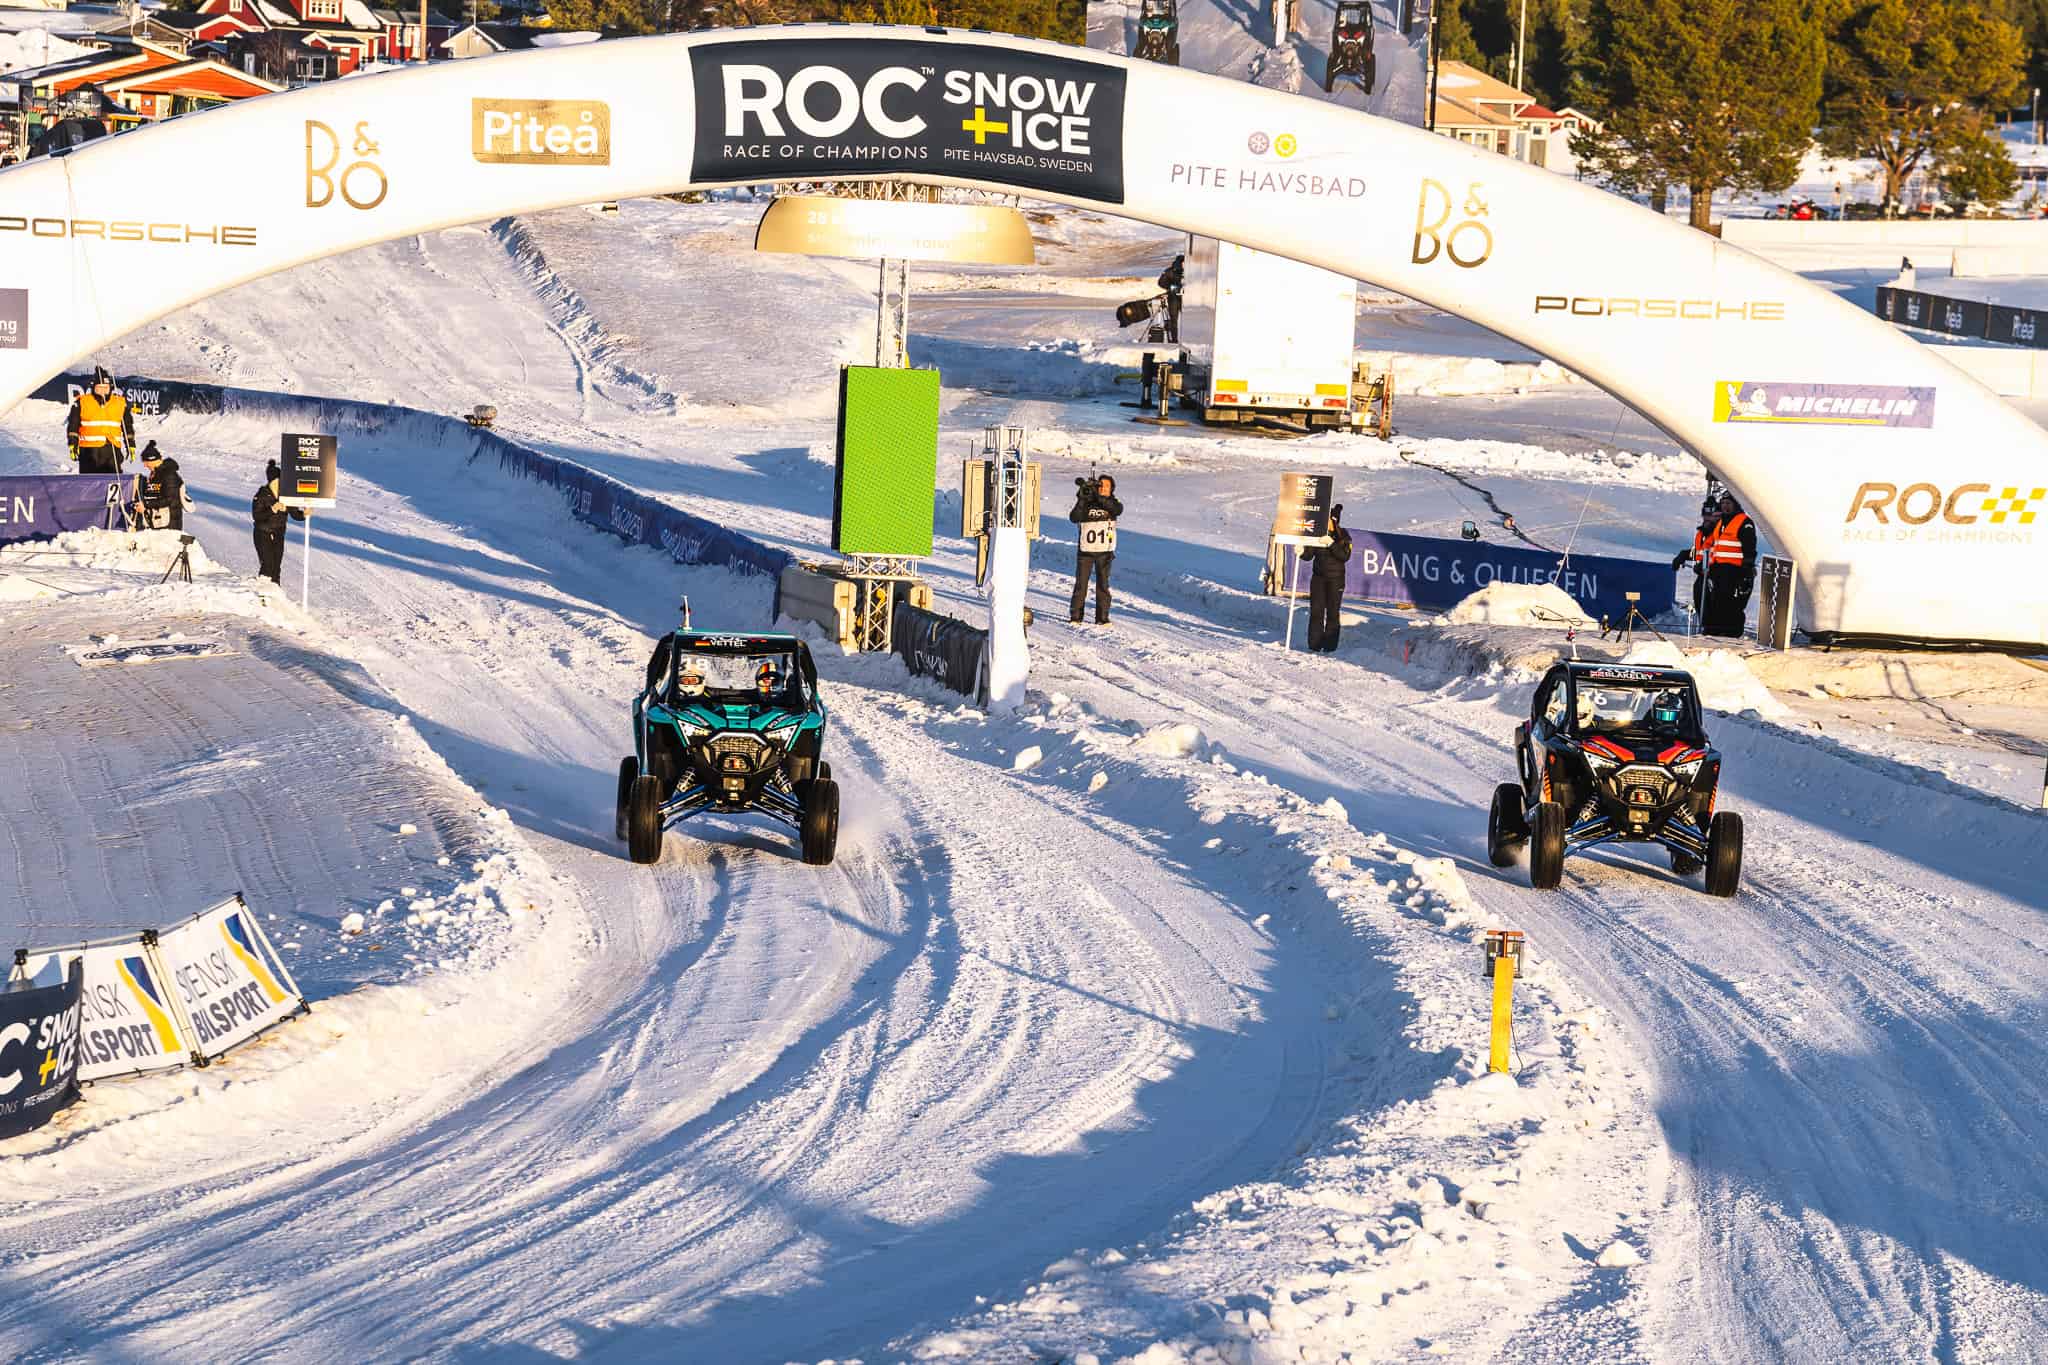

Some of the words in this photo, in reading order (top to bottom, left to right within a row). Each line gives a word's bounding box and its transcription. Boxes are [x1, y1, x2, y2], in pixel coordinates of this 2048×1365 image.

[721, 64, 928, 138] ROC
[943, 70, 1096, 116] SNOW
[483, 110, 599, 153] Piteå
[723, 144, 771, 159] RACE
[779, 144, 804, 160] OF
[813, 144, 928, 160] CHAMPIONS
[944, 148, 971, 161] PITE
[1039, 158, 1093, 173] SWEDEN
[1171, 163, 1227, 188] PITE
[1239, 169, 1366, 198] HAVSBAD
[0, 216, 256, 246] PORSCHE
[1534, 295, 1784, 320] PORSCHE
[127, 388, 160, 404] SNOW
[1775, 396, 1918, 415] MICHELIN
[109, 484, 119, 502] 2
[1846, 482, 1991, 525] ROC
[1363, 549, 1440, 582] BANG
[1450, 559, 1464, 584] &
[192, 981, 271, 1045] BILSPORT
[79, 1023, 159, 1067] ILSPORT
